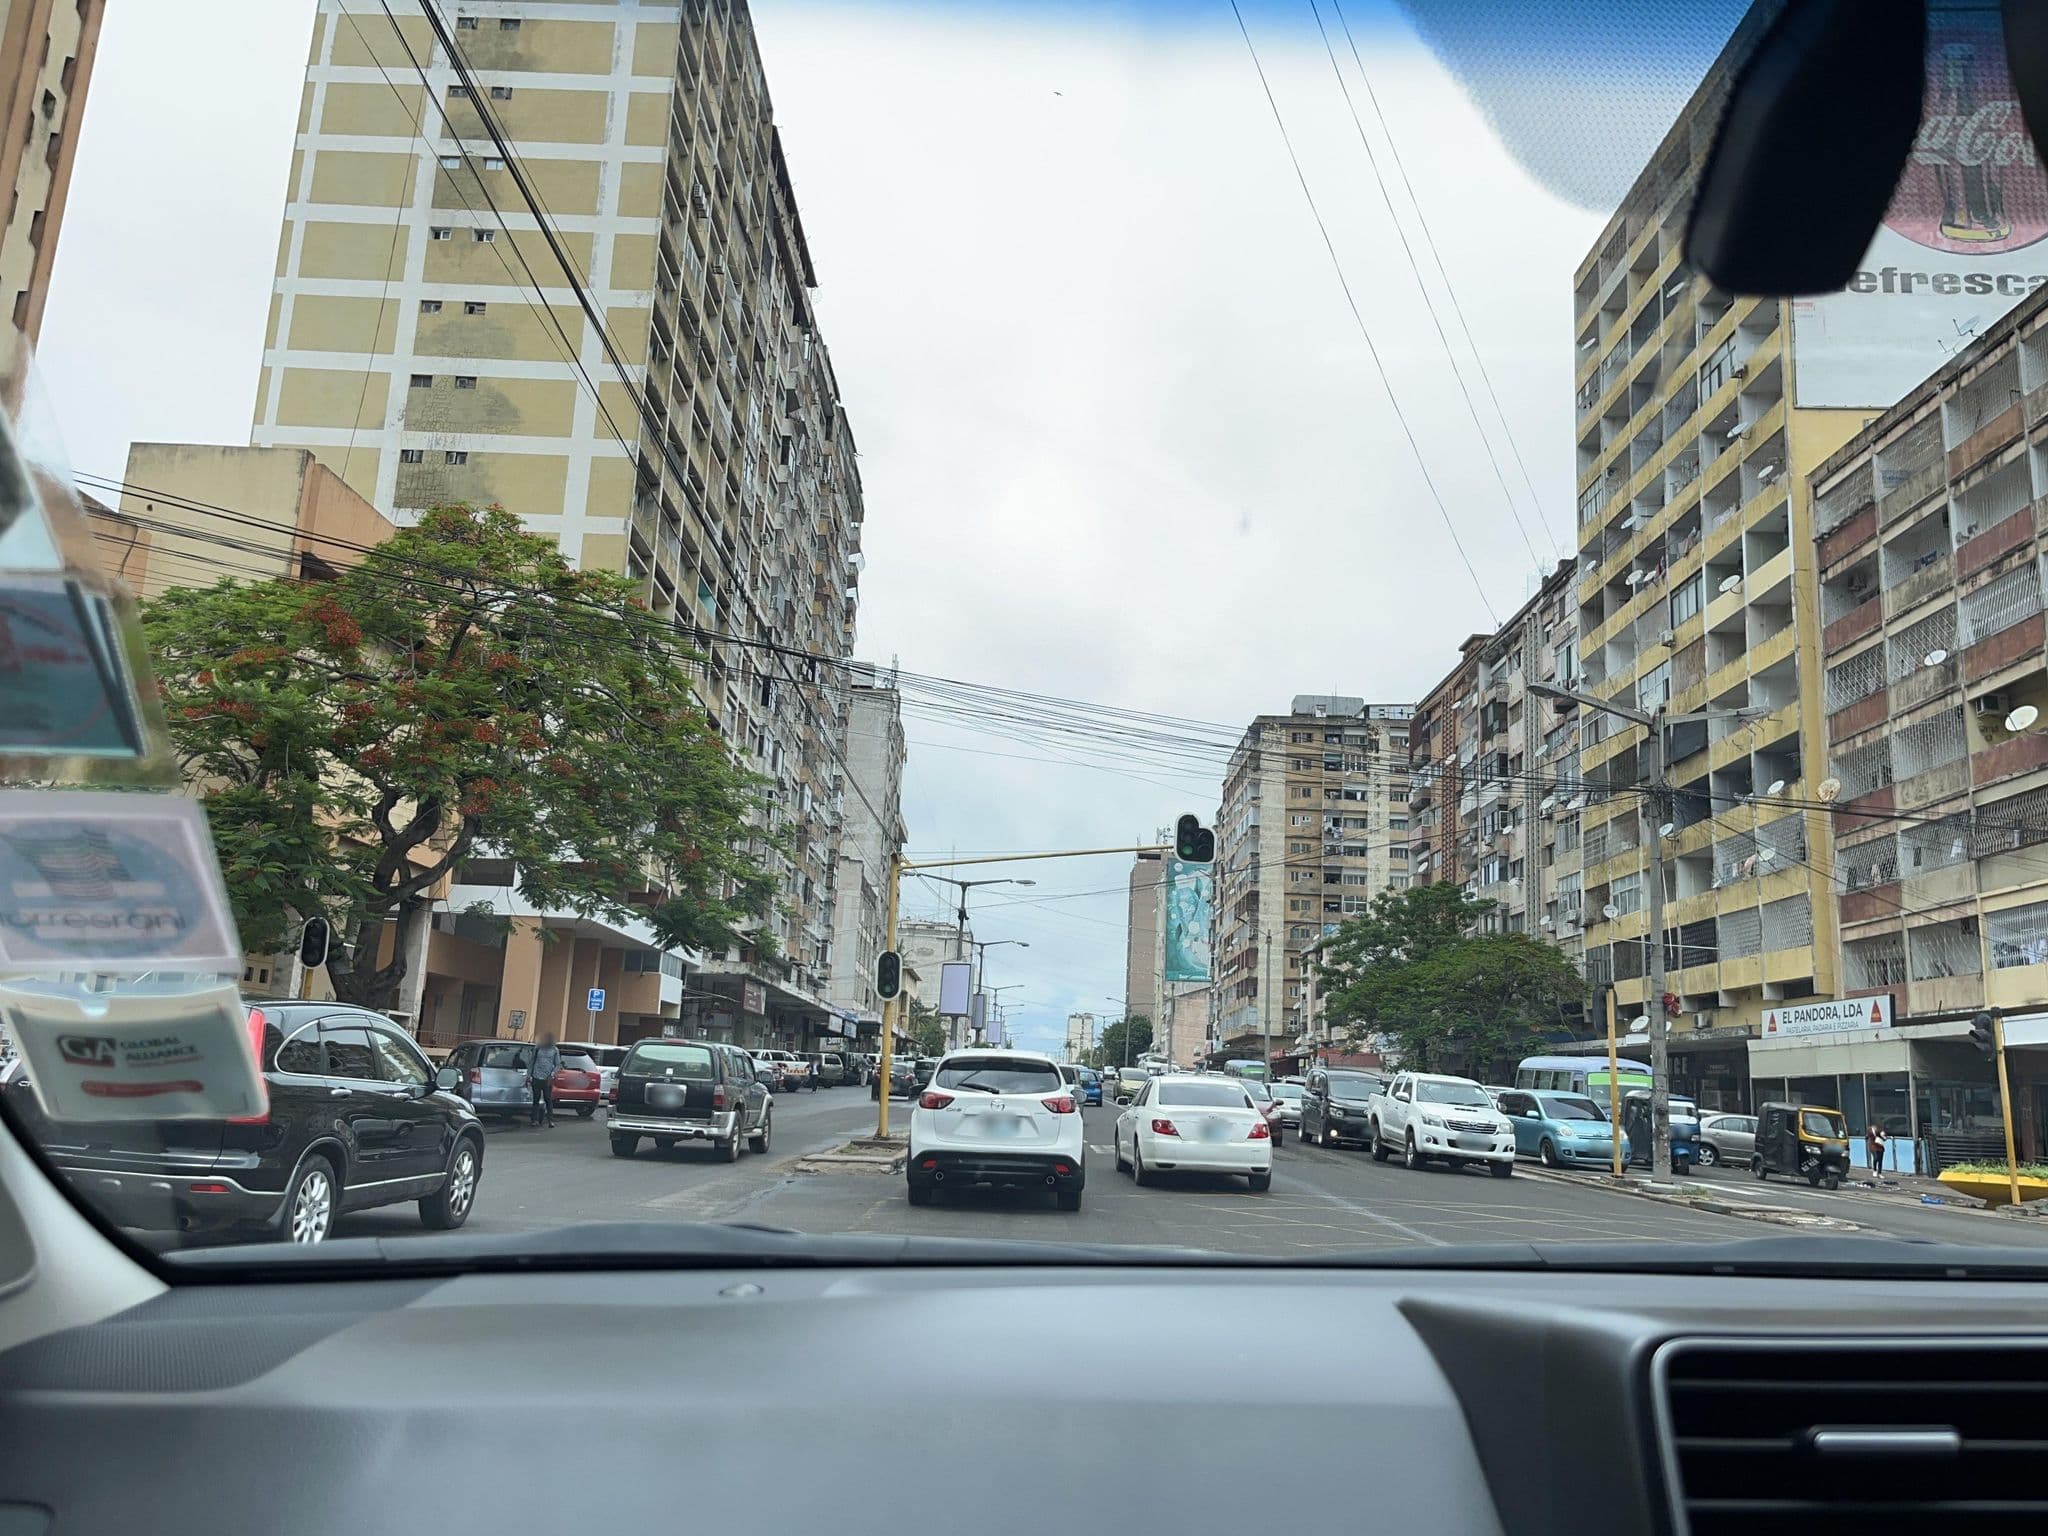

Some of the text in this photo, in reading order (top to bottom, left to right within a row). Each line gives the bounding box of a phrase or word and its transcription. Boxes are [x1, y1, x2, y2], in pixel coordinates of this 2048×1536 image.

[1782, 1002, 1863, 1024] EL PANDORA, LDA
